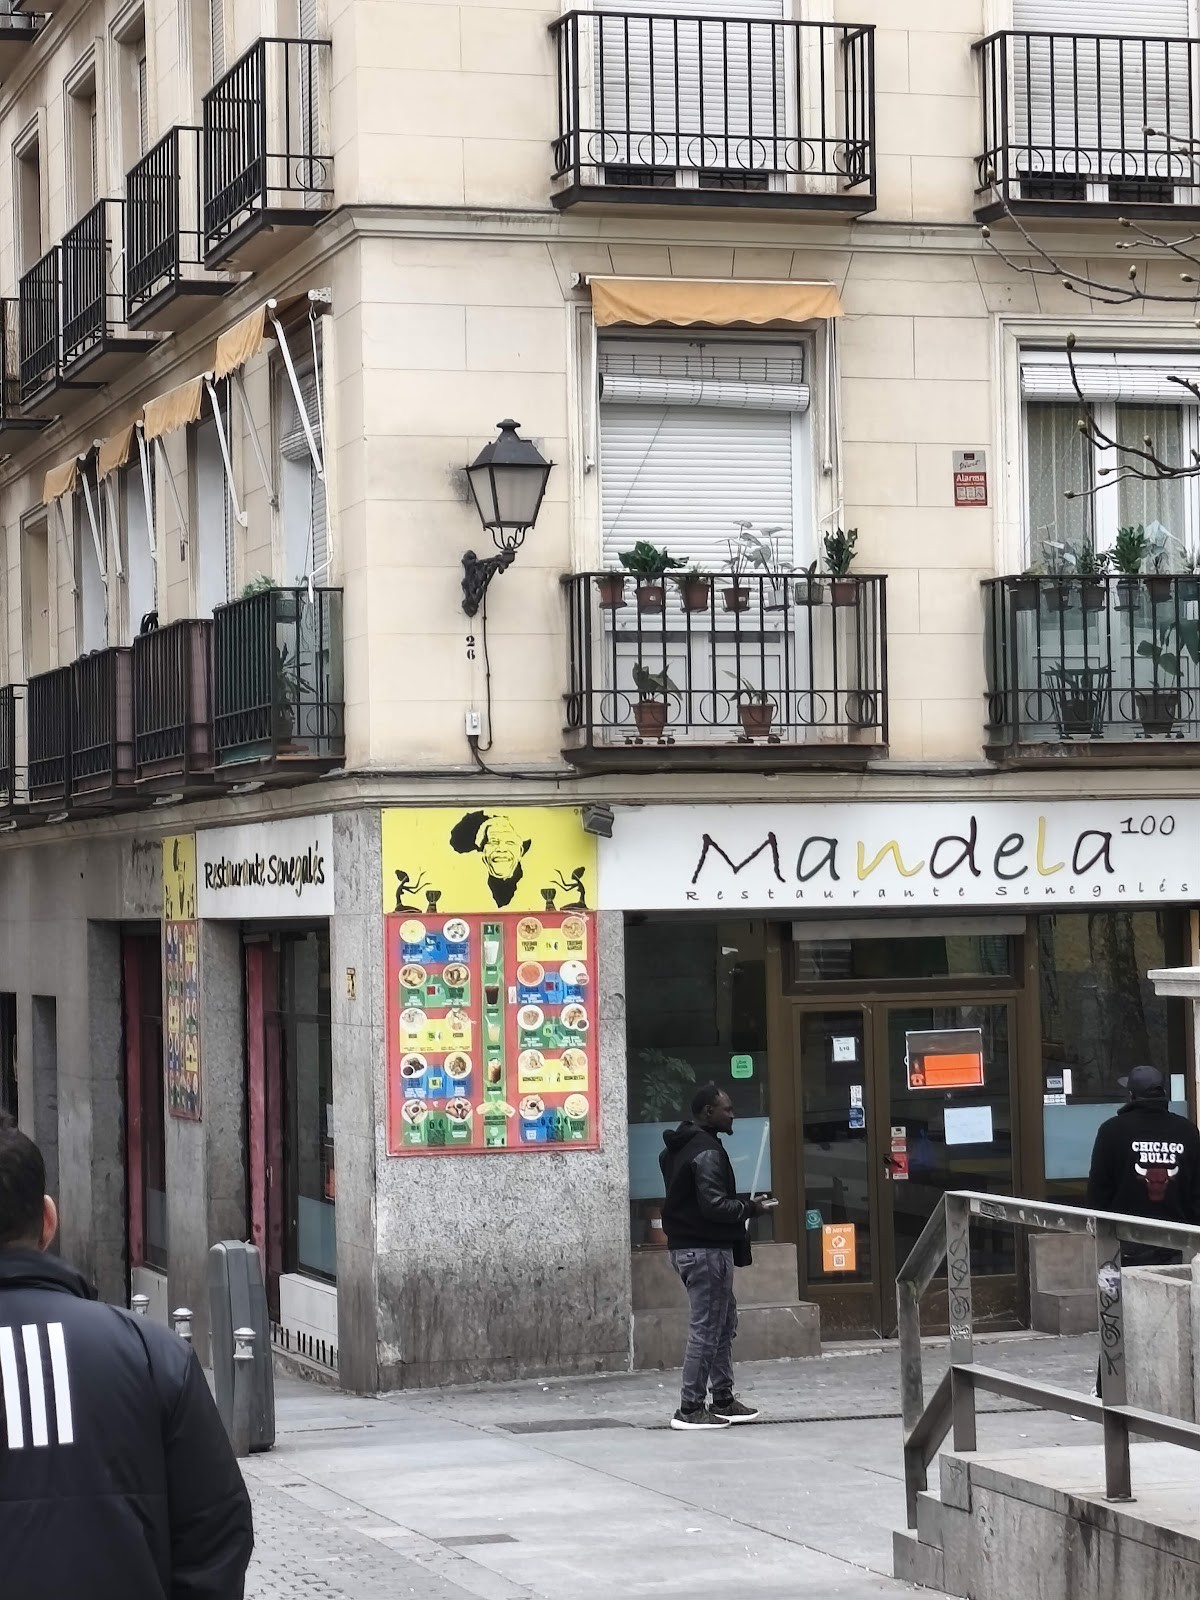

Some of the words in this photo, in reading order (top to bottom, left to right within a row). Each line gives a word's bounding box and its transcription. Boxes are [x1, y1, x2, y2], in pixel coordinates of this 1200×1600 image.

[691, 816, 1116, 884] Mandela
[1119, 815, 1176, 837] 100
[204, 853, 265, 890] Restaurante
[267, 840, 325, 897] Senegalés
[685, 886, 965, 901] Restaurante
[995, 880, 1189, 898] Senegalés
[1131, 1141, 1184, 1154] CHICAGO
[1139, 1153, 1176, 1163] BULLS
